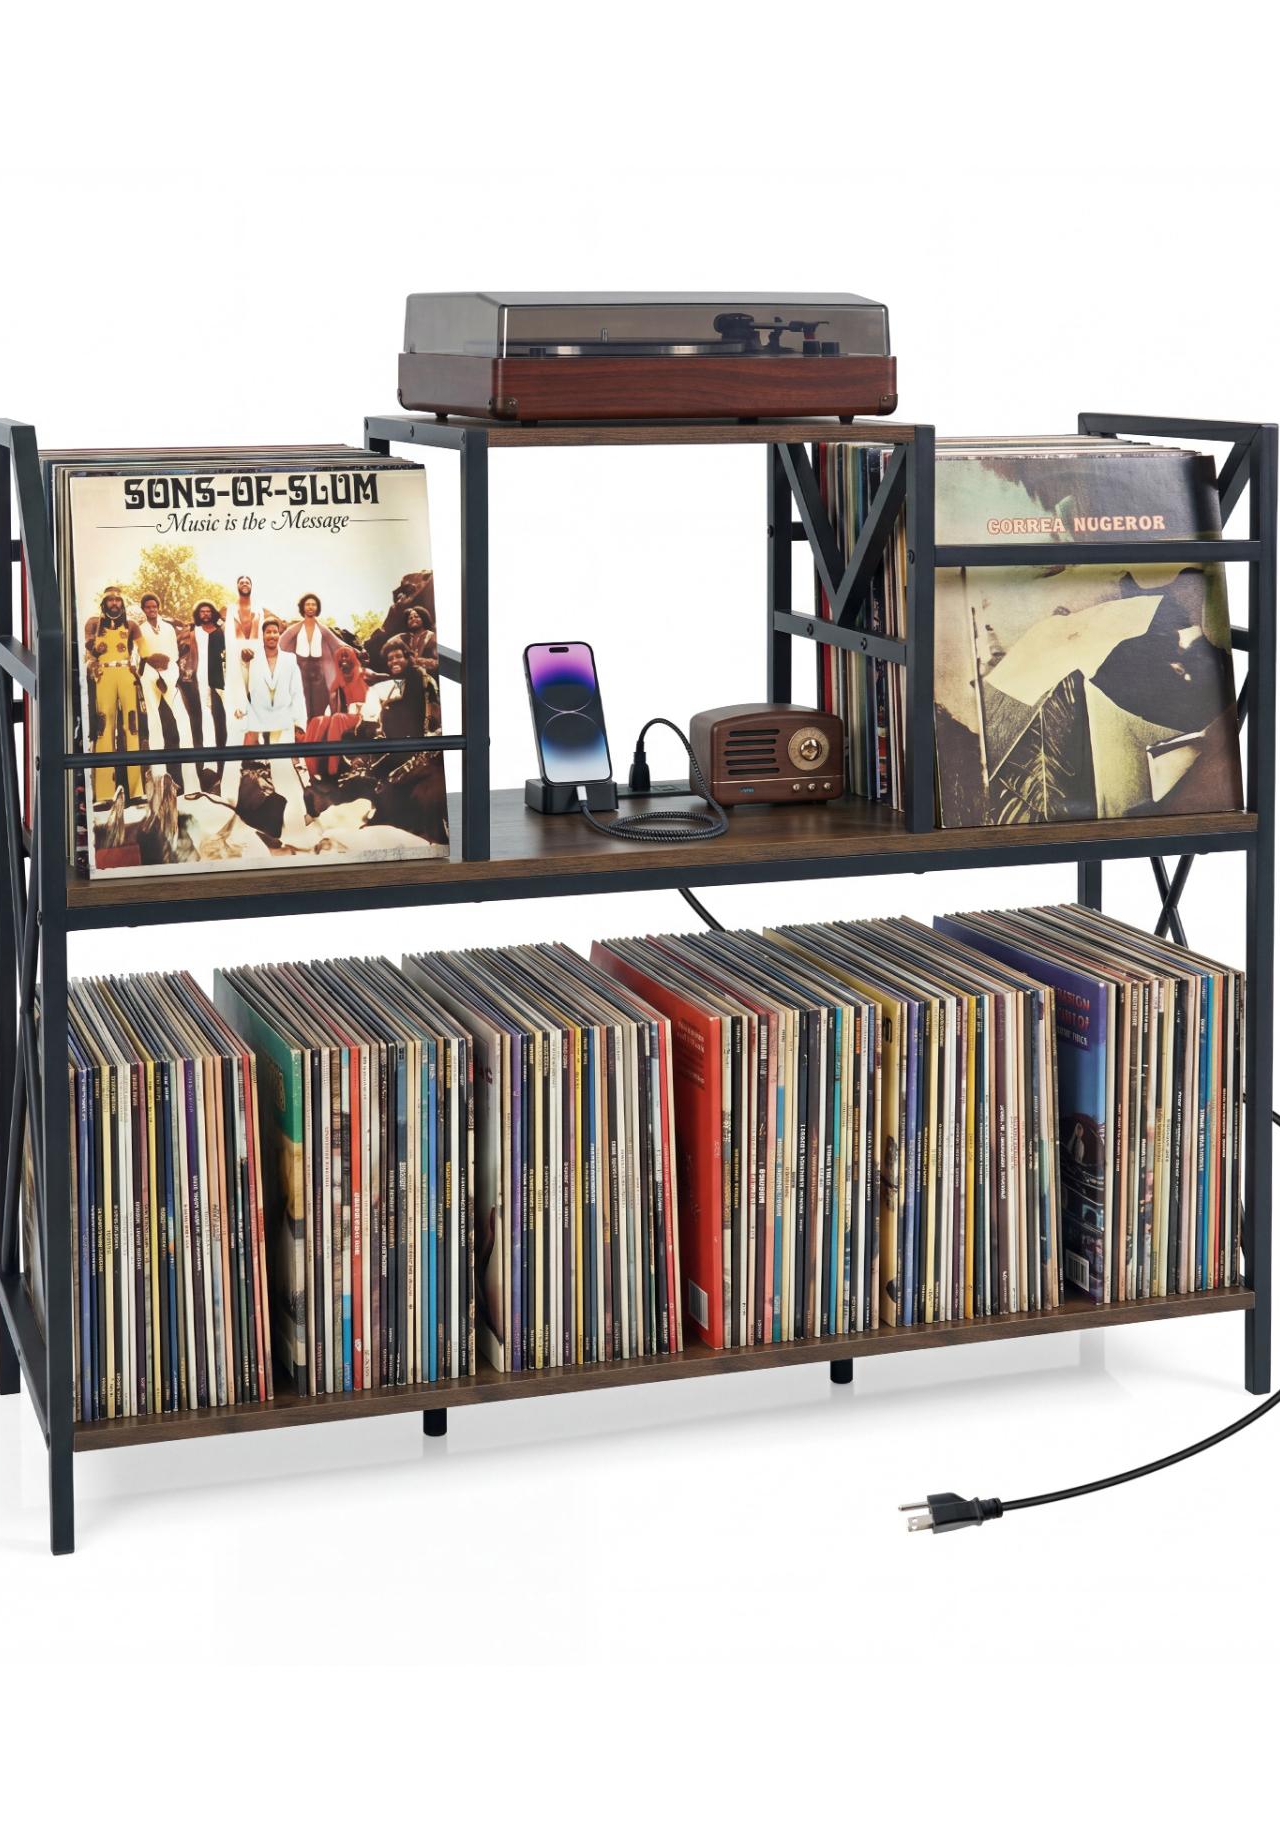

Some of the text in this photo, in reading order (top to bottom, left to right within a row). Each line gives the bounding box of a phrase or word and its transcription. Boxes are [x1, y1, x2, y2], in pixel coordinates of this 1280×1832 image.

[124, 473, 379, 509] SONS-OF-SLUM
[156, 510, 349, 533] Music is the Message
[987, 515, 1165, 534] CORREA NUGEROR
